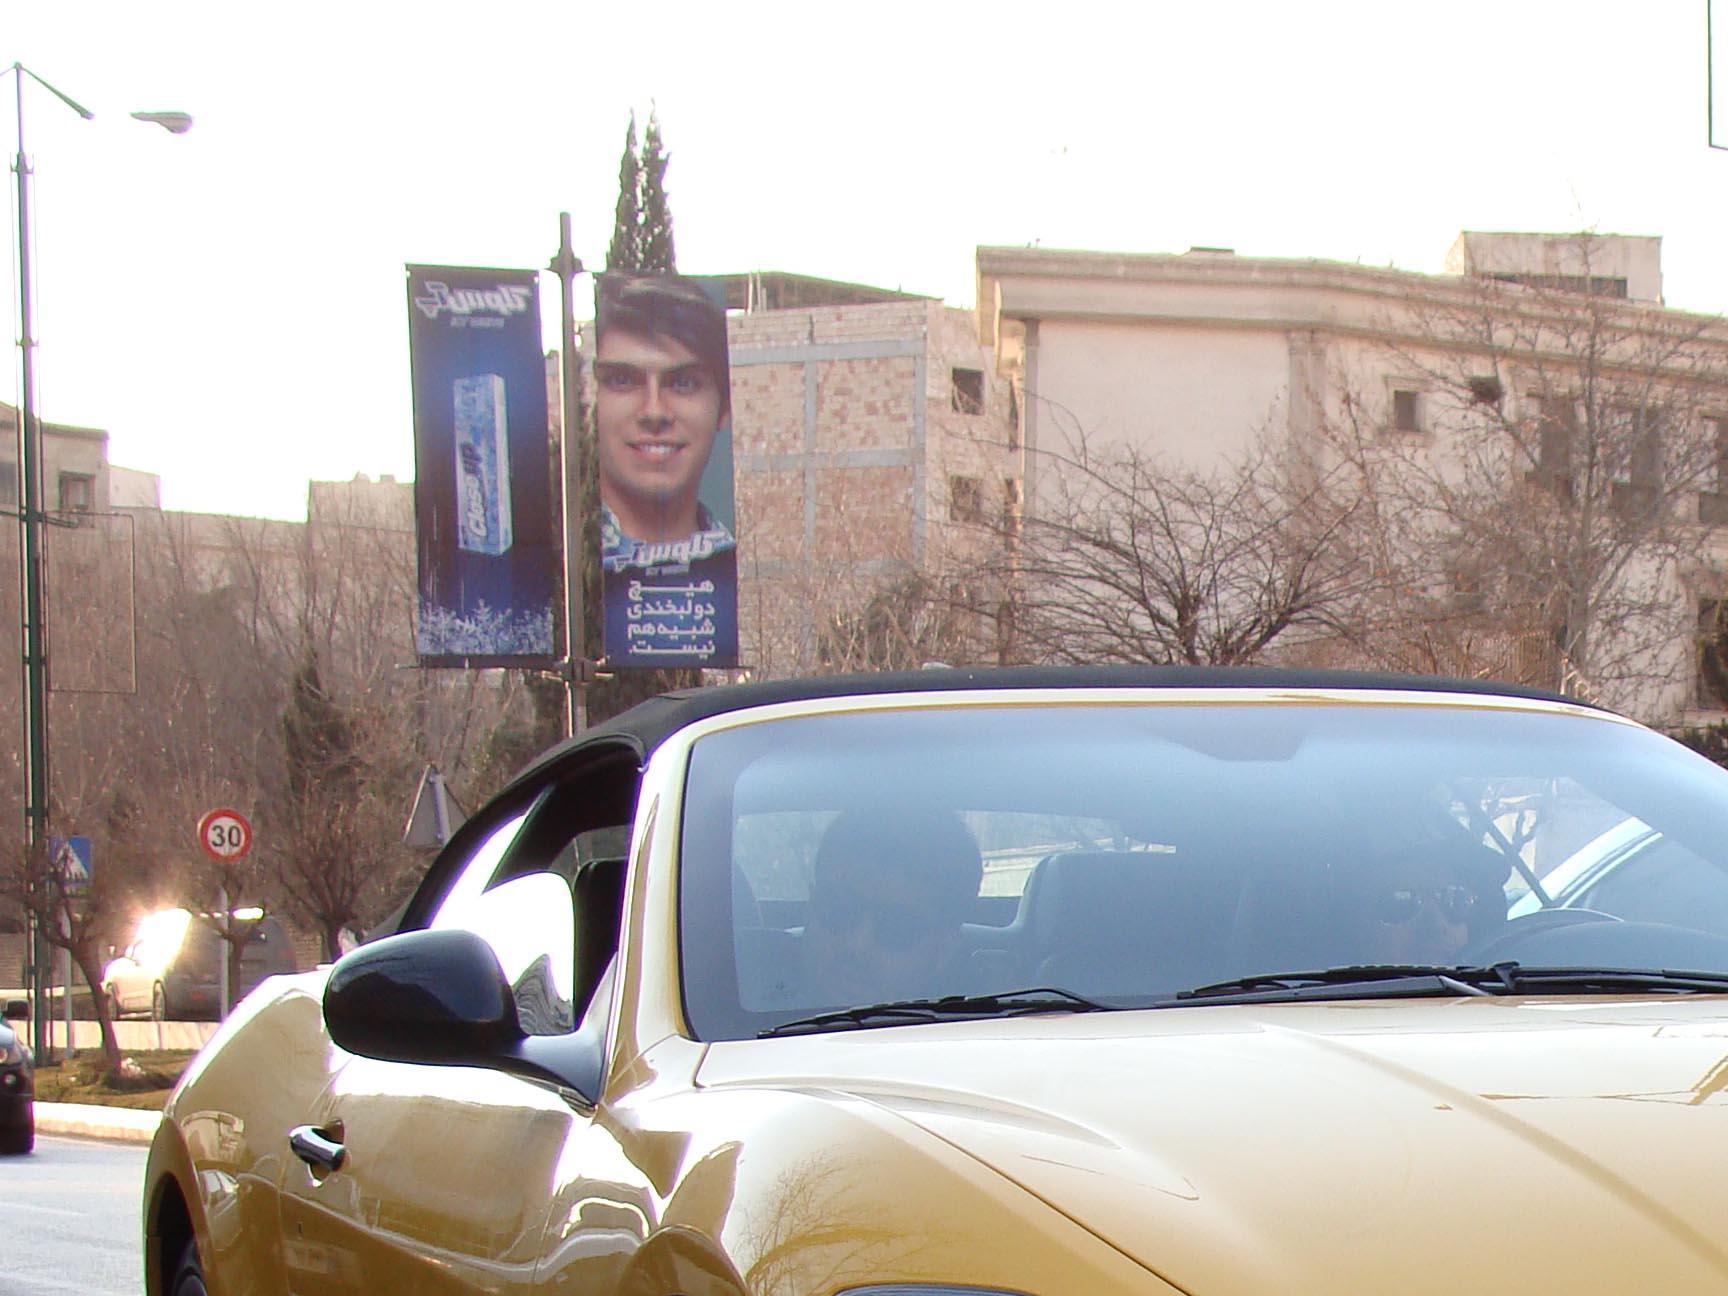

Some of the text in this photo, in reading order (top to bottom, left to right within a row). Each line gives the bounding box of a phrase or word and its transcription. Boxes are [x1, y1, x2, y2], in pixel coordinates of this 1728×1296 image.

[628, 580, 715, 600] هیچ
[627, 618, 715, 639] شبیه هم
[211, 825, 240, 849] 30
